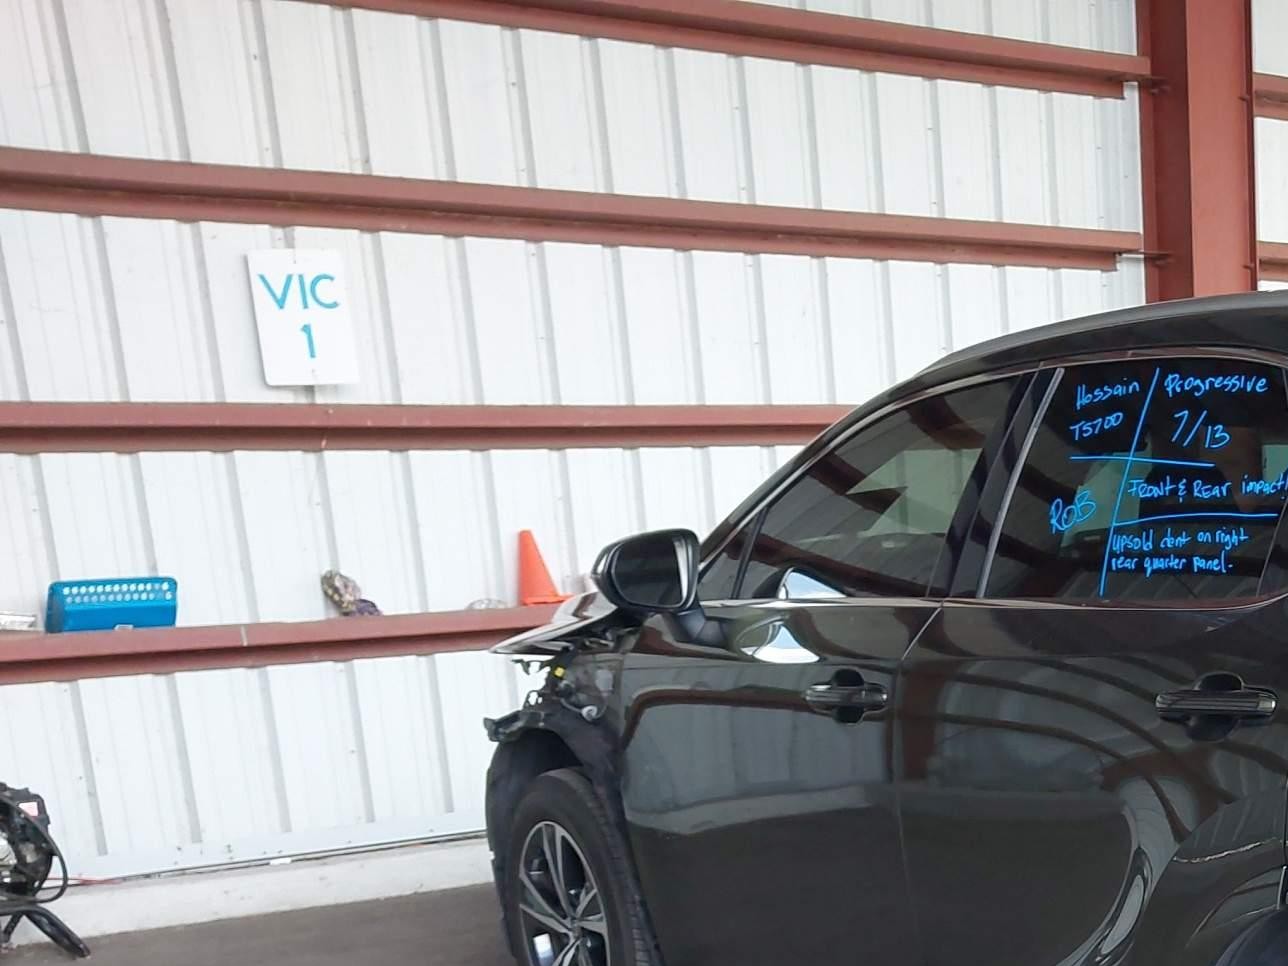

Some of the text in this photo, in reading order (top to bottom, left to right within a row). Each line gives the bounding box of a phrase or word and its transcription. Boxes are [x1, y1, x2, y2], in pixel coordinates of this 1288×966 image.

[257, 272, 341, 310] VIC
[300, 323, 316, 359] 1
[1076, 377, 1140, 411] Hossain
[1164, 373, 1268, 398] Progressive
[1197, 532, 1212, 543] on
[1111, 556, 1138, 571] rear
[1143, 554, 1187, 578] quarter
